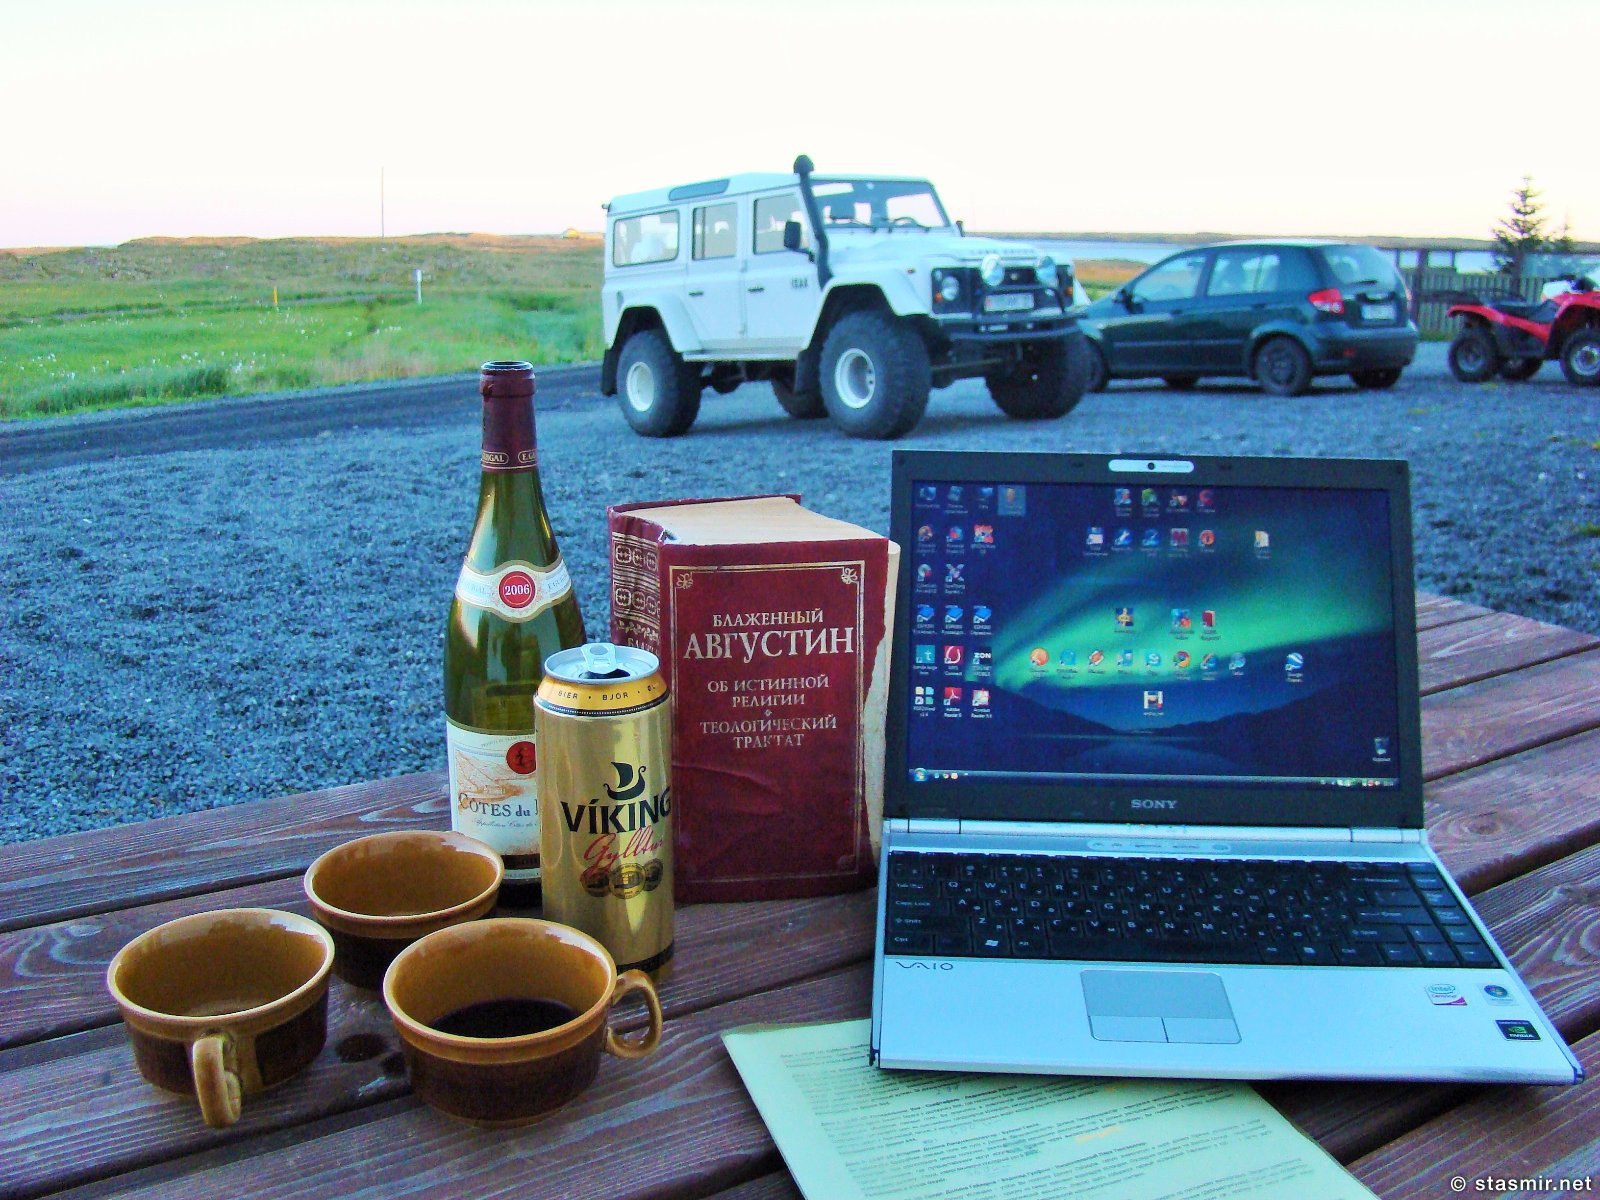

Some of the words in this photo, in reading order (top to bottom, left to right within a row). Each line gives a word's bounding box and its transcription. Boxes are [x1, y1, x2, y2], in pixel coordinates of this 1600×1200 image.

[504, 583, 530, 596] 2006
[712, 607, 824, 627] БЛАЖЕННЫЙ
[683, 627, 854, 664] АВГУСТИН
[707, 680, 729, 692] ОБ
[734, 673, 830, 691] ИСТИННОЙ
[558, 690, 578, 699] BIER
[732, 693, 805, 708] РЕЛИГИИ
[699, 713, 837, 734] ТЕОЛОГИЧЕСКИЙ
[733, 733, 805, 749] ТРАКТАТ
[515, 804, 531, 817] du
[560, 786, 672, 834] VÍKING
[1130, 799, 1178, 809] SONY
[895, 961, 954, 971] VAIO
